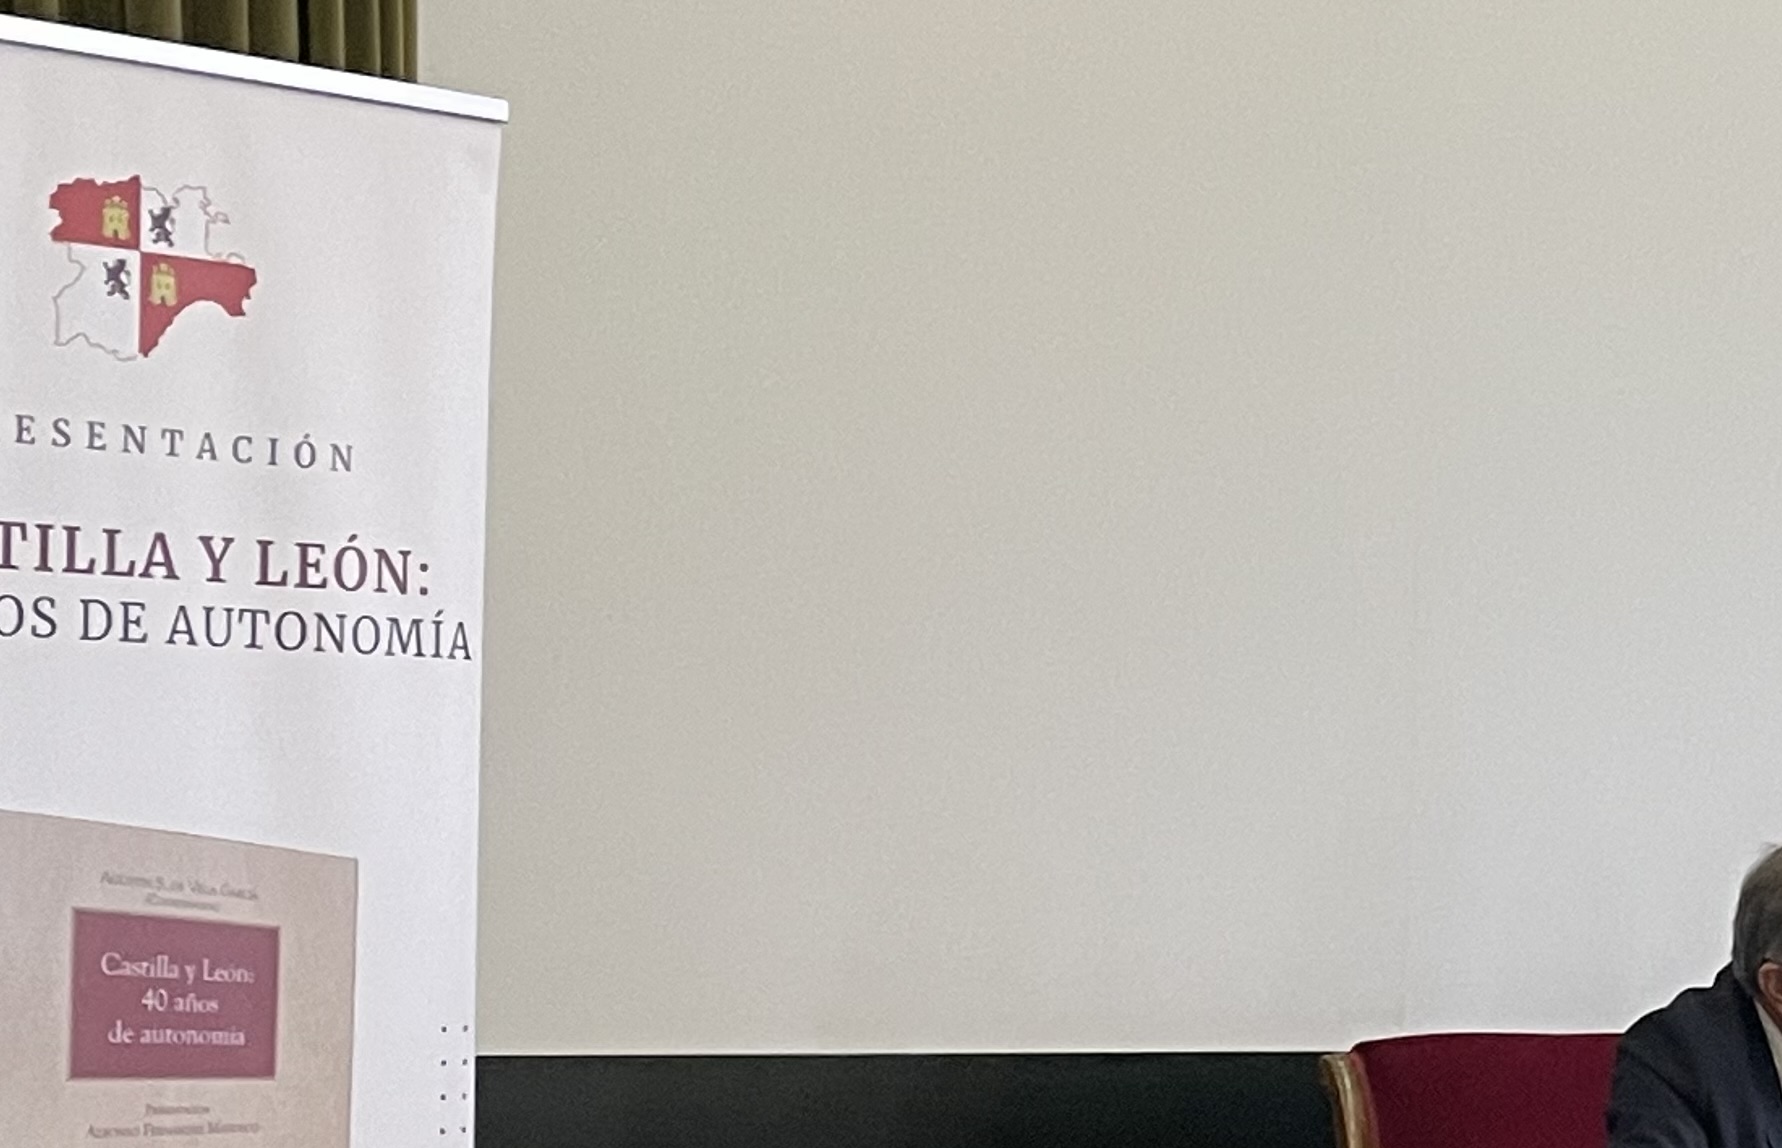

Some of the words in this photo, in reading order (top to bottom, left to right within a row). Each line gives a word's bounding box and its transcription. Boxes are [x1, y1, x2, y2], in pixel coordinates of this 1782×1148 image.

[14, 414, 354, 473] ESENTACIÓN
[0, 520, 181, 581] TILLA
[198, 535, 235, 583] Y
[254, 533, 430, 596] LEÓN:
[0, 594, 58, 638] OS
[79, 598, 149, 644] DE
[165, 605, 473, 661] AUTONOMÍA
[100, 952, 180, 980] Castilla
[184, 964, 197, 985] y
[141, 987, 169, 1012] 40
[173, 992, 220, 1013] años
[107, 1019, 135, 1044] de
